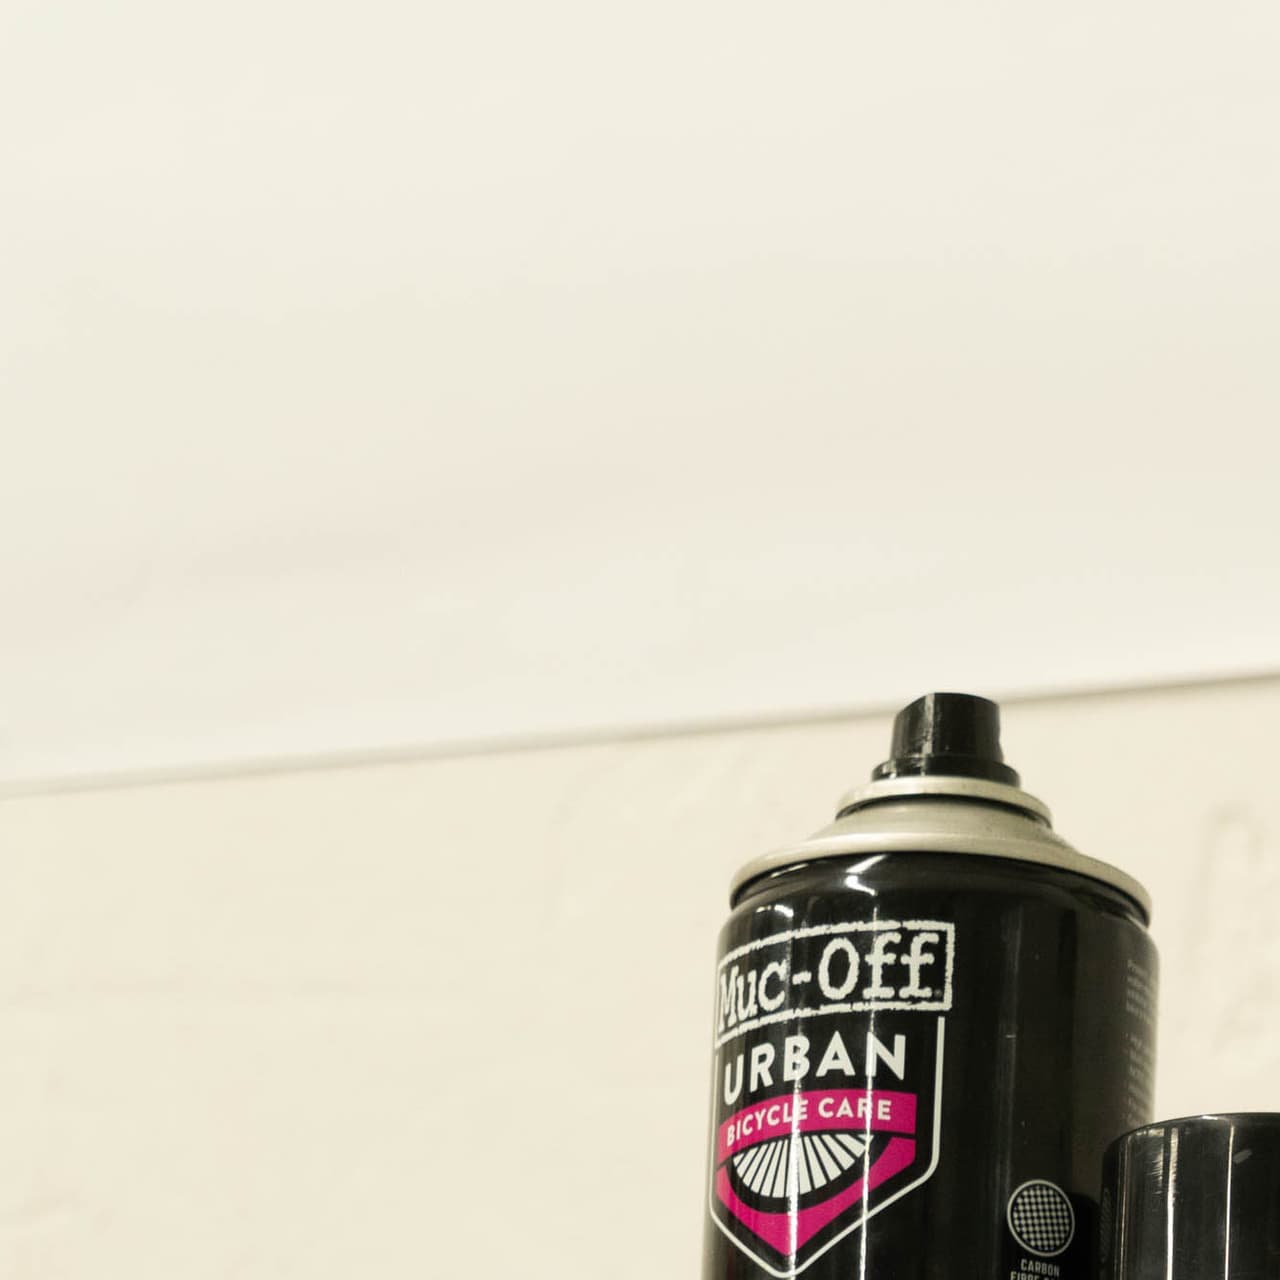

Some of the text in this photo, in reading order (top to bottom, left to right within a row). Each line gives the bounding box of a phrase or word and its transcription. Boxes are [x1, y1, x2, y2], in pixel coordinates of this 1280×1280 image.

[718, 931, 941, 1031] Muc-Off
[723, 1031, 907, 1105] URBAN
[726, 1097, 892, 1147] BICYCLE CARE
